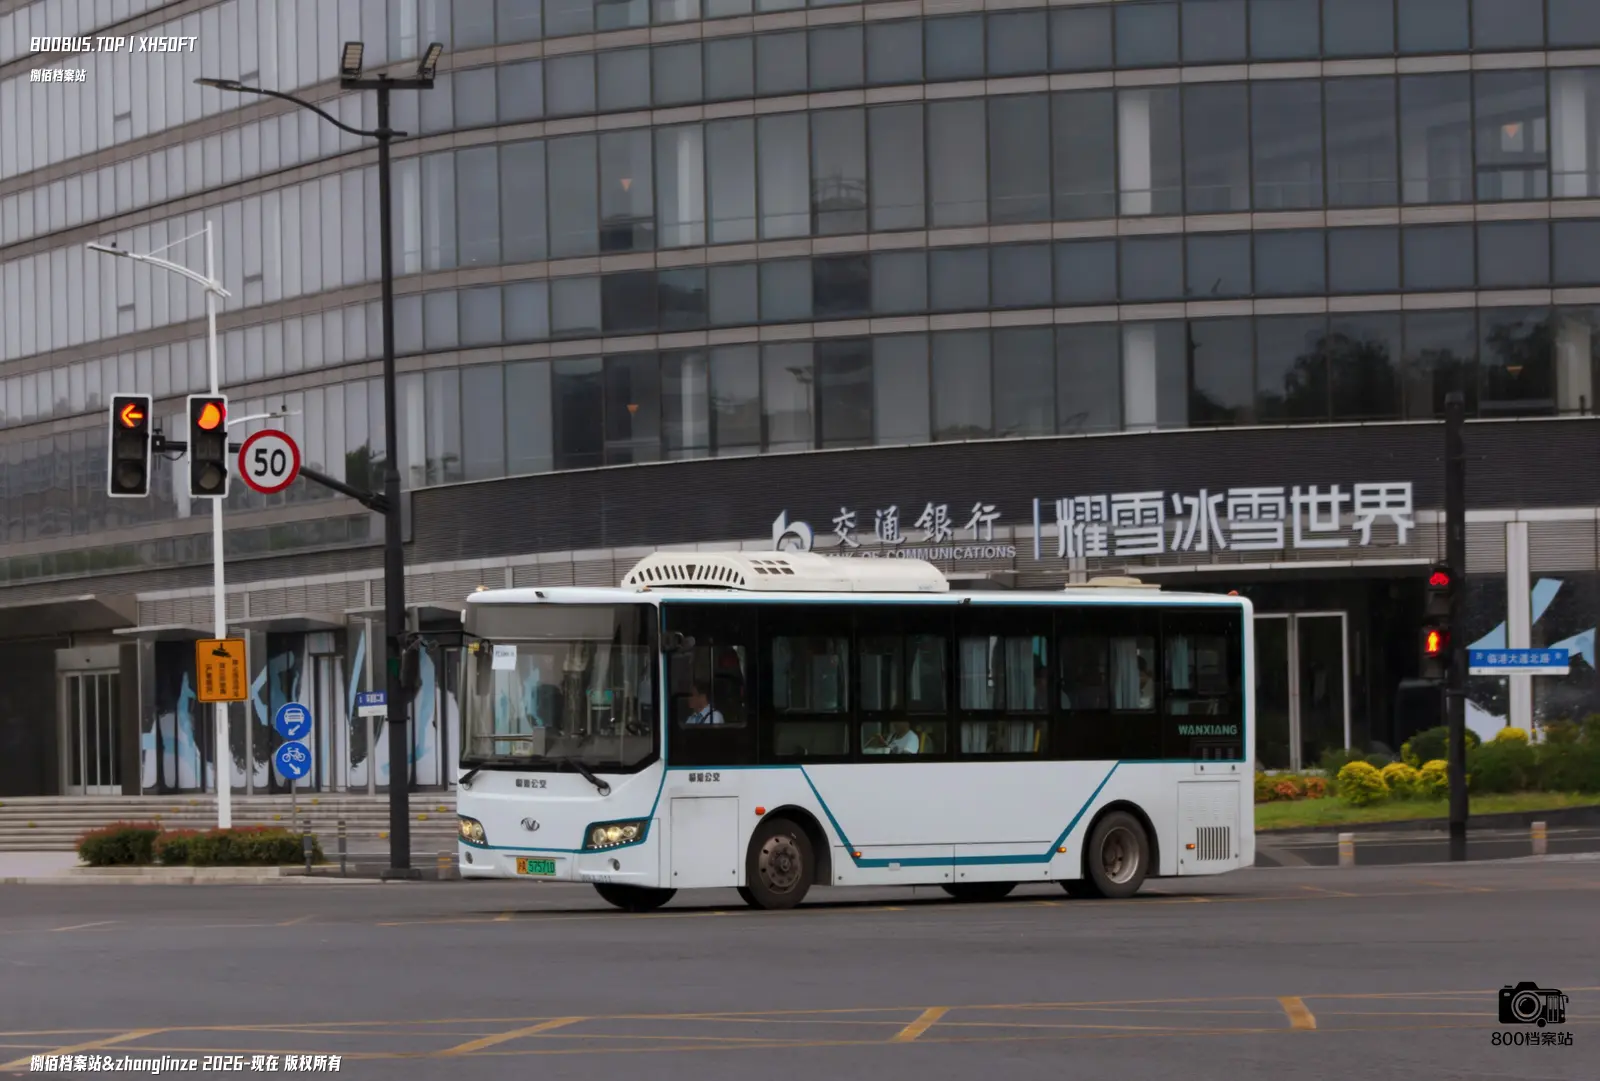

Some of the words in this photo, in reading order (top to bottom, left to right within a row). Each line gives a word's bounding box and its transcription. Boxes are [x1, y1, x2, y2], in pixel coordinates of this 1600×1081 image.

[254, 448, 287, 477] 50
[831, 501, 1002, 549] 交通銀行
[1055, 481, 1415, 558] 耀雪冰雪世界
[886, 545, 1017, 560] COMMUNICATIONS
[1178, 724, 1238, 736] WANXIANG
